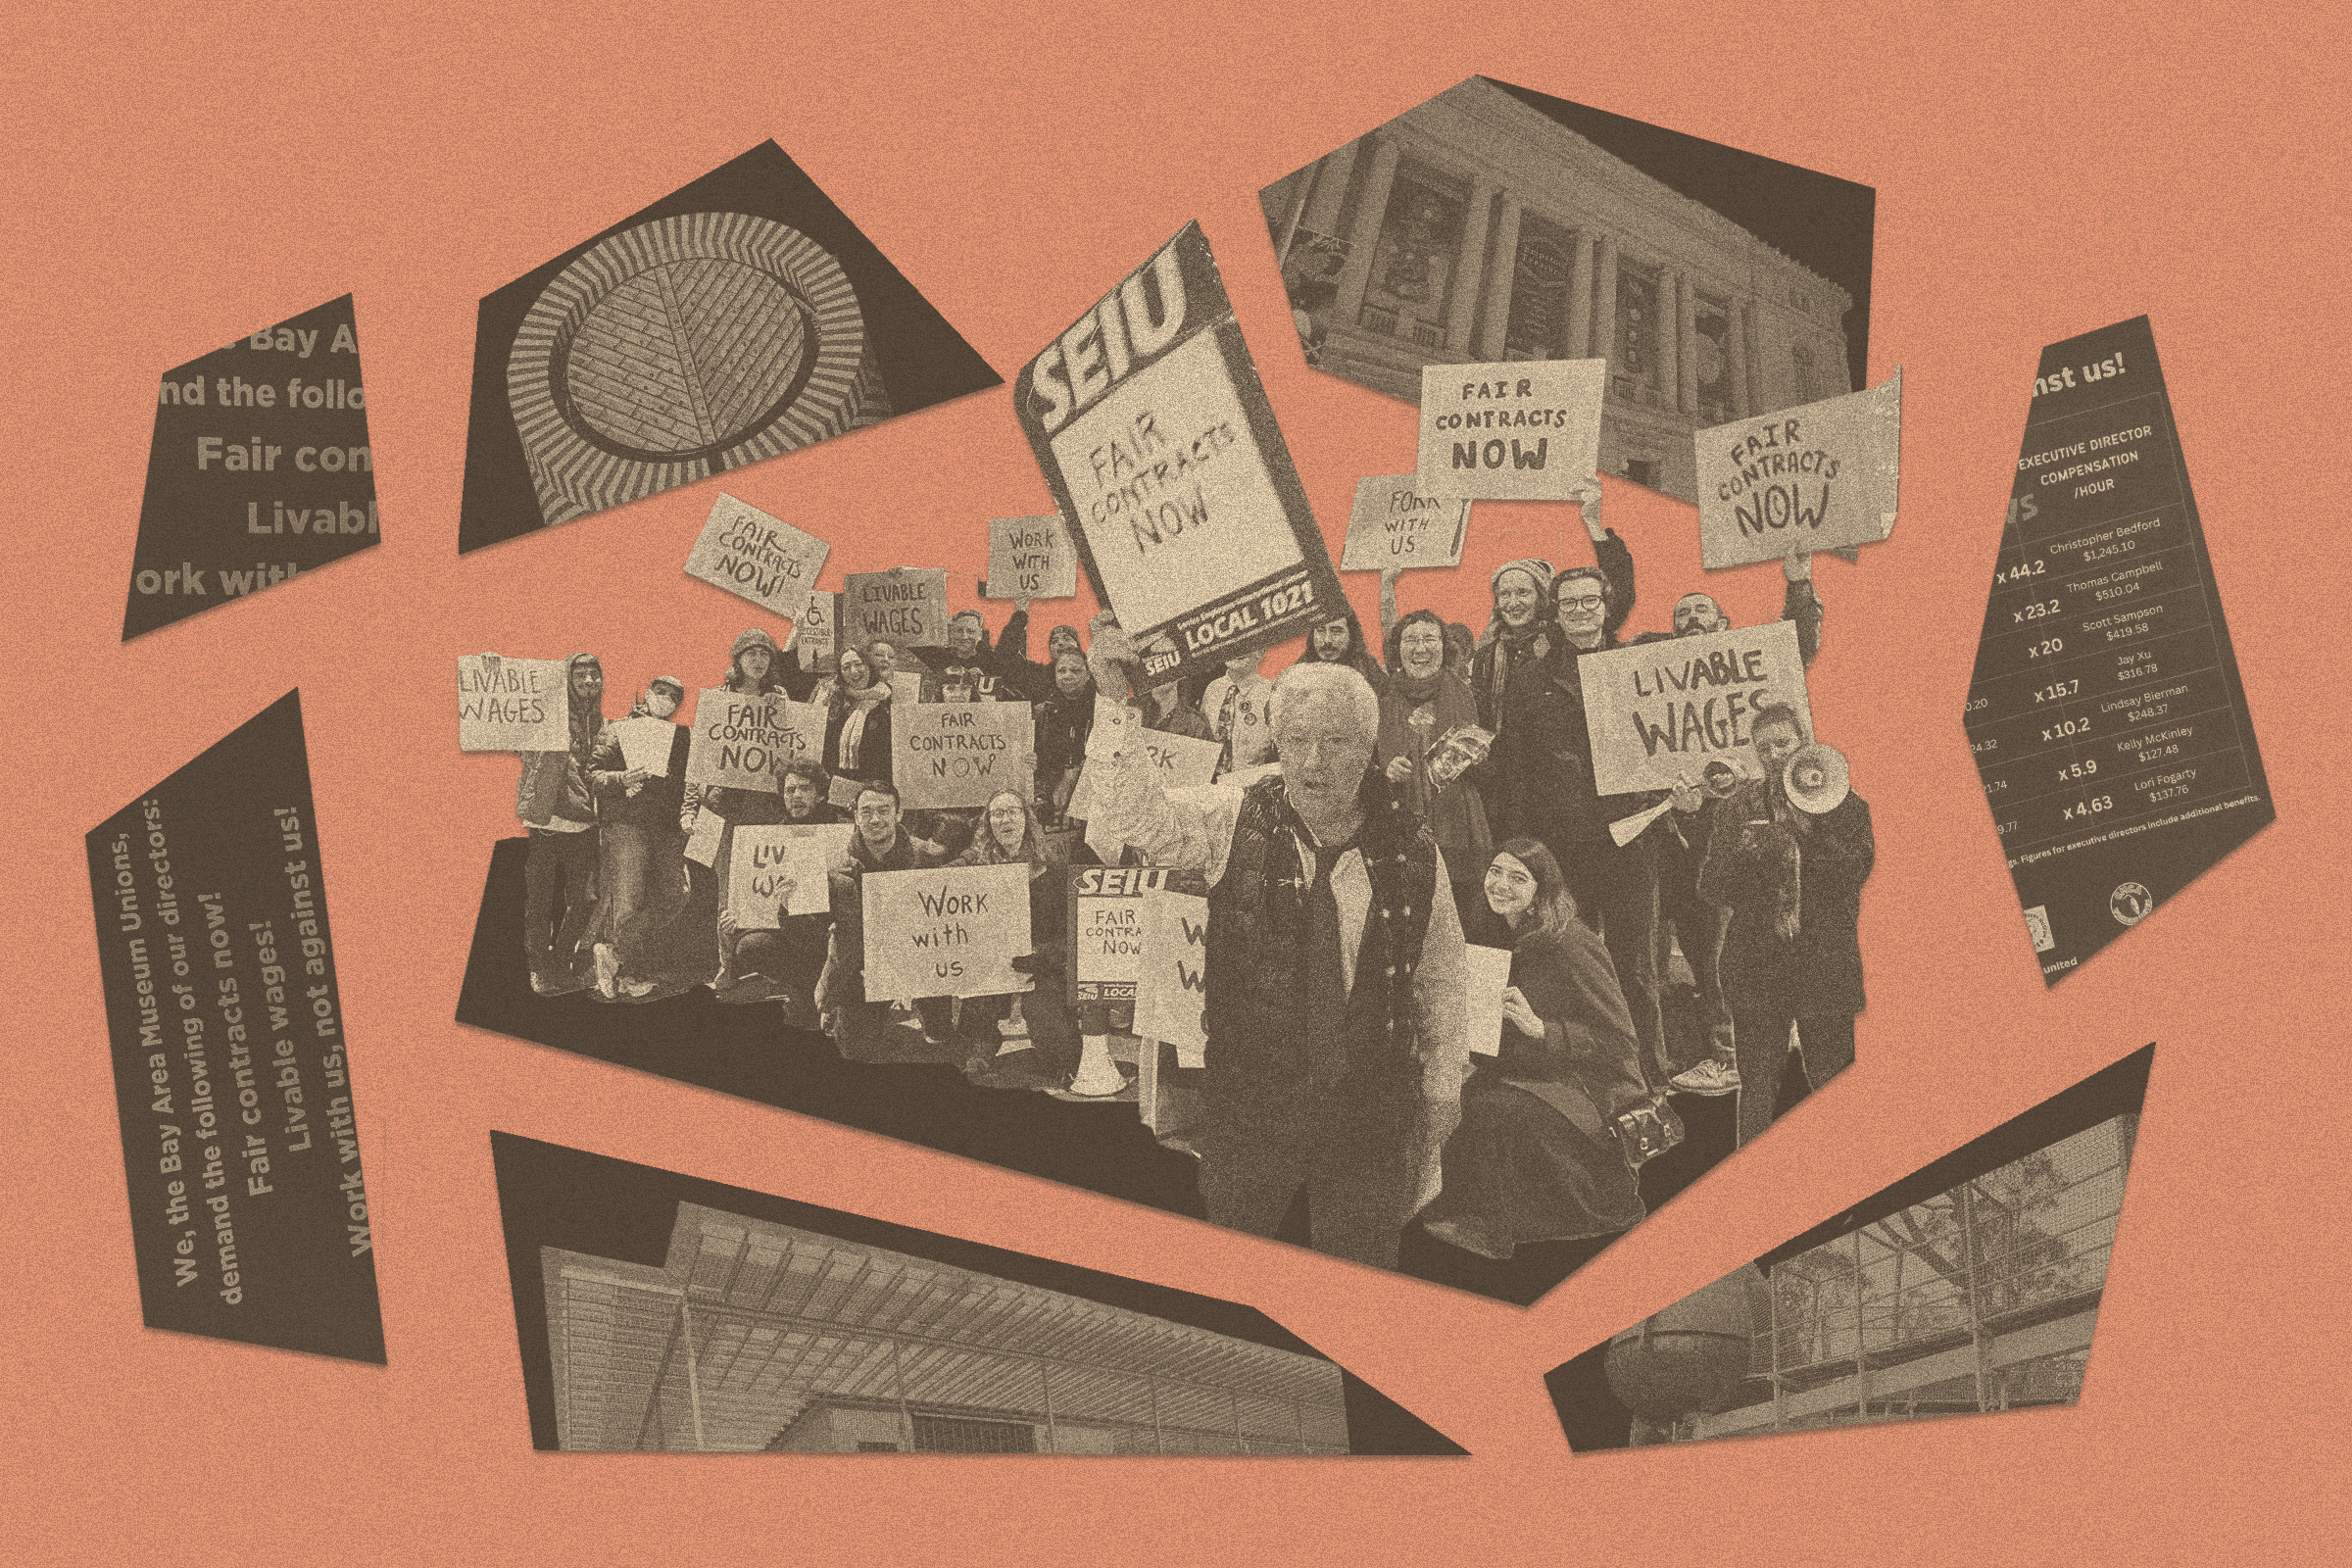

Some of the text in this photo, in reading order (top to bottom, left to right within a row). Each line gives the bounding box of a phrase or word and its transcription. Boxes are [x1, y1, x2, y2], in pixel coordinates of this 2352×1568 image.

[250, 325, 318, 359] Bay
[1032, 245, 1188, 434] SEIU
[2082, 351, 2126, 383] us!
[217, 376, 276, 408] the
[1462, 378, 1533, 401] FAIR
[1436, 409, 1567, 431] CONTRACTS
[197, 436, 282, 471] Fair
[1089, 410, 1166, 489] FAIR
[1452, 438, 1547, 470] NOW
[1731, 417, 1801, 467] FAIR
[2018, 424, 2152, 470] EXECUTIVE DIRECTOR
[1091, 423, 1237, 523] CONTRACTS
[1718, 450, 1841, 503] CONTRACTS
[2040, 450, 2139, 486] COMPENSATION
[2075, 478, 2115, 499] /HOUR
[1130, 485, 1209, 554] NOW
[1735, 482, 1829, 537] NOW
[731, 515, 786, 553] FAIR
[1385, 517, 1430, 534] WITH
[2050, 517, 2161, 554] Christopher Bedford
[1009, 529, 1054, 550] WORK
[1391, 536, 1415, 555] US
[2083, 540, 2135, 562] $1,245.10
[719, 532, 801, 578] CONTRACTS
[1012, 554, 1050, 569] WITH
[714, 554, 785, 597] NOW!
[1019, 573, 1040, 590] US
[2010, 560, 2045, 579] 44.2
[2066, 561, 2163, 593] Thomas Campbell
[862, 582, 926, 603] LIVABLE
[2095, 582, 2140, 601] $510.04
[862, 607, 923, 635] WAGES
[1186, 606, 1258, 651] LOCAL
[1261, 580, 1314, 619] 1021
[2026, 599, 2061, 619] 23.2
[2082, 605, 2164, 632] Scott Sampson
[2106, 622, 2149, 642] $419.58
[2040, 638, 2063, 655] 20
[2117, 652, 2151, 665] Jay Xu
[1144, 650, 1181, 676] SEIU
[1635, 649, 1768, 698] LIVABLE
[2117, 663, 2157, 681] $316.78
[460, 668, 542, 694] LIVABLE
[2046, 679, 2079, 700] 15.7
[460, 698, 545, 724] WAGES
[2100, 685, 2188, 712] Lindsay Bierman
[728, 704, 794, 732] FAIR
[942, 712, 976, 728] FAIR
[2128, 704, 2168, 722] $248.37
[709, 724, 807, 750] CONTRACTS
[2054, 717, 2091, 738] 10.2
[2117, 727, 2193, 752] Kelly McKinley
[909, 734, 1006, 752] CONTRACTS
[2138, 744, 2179, 762] $127.48
[932, 754, 996, 777] NOW
[2070, 760, 2097, 778] 5.9
[2133, 768, 2196, 791] Lori Fogarty
[2076, 796, 2113, 815] 4.63
[2149, 784, 2189, 803] $137.76
[2021, 851, 2051, 863] Figures
[2052, 846, 2066, 856] for
[2066, 835, 2107, 851] executive
[2108, 823, 2146, 840] directors
[2147, 815, 2179, 829] include
[2180, 804, 2223, 820] additional
[2224, 795, 2261, 809] benefits.
[754, 845, 785, 868] LIV
[1078, 868, 1168, 895] SEIU
[1096, 909, 1136, 925] FAIR
[911, 923, 968, 948] with
[1103, 940, 1142, 955] NOW
[2043, 956, 2078, 974] united
[198, 892, 273, 1197] Fair contracts now!
[249, 920, 312, 1152] Livable wages!
[273, 807, 371, 1257] Work with us, not against us!
[112, 834, 198, 1287] We, the Bay Area Museum Unions,
[143, 800, 242, 1304] demand the following of our directors:
